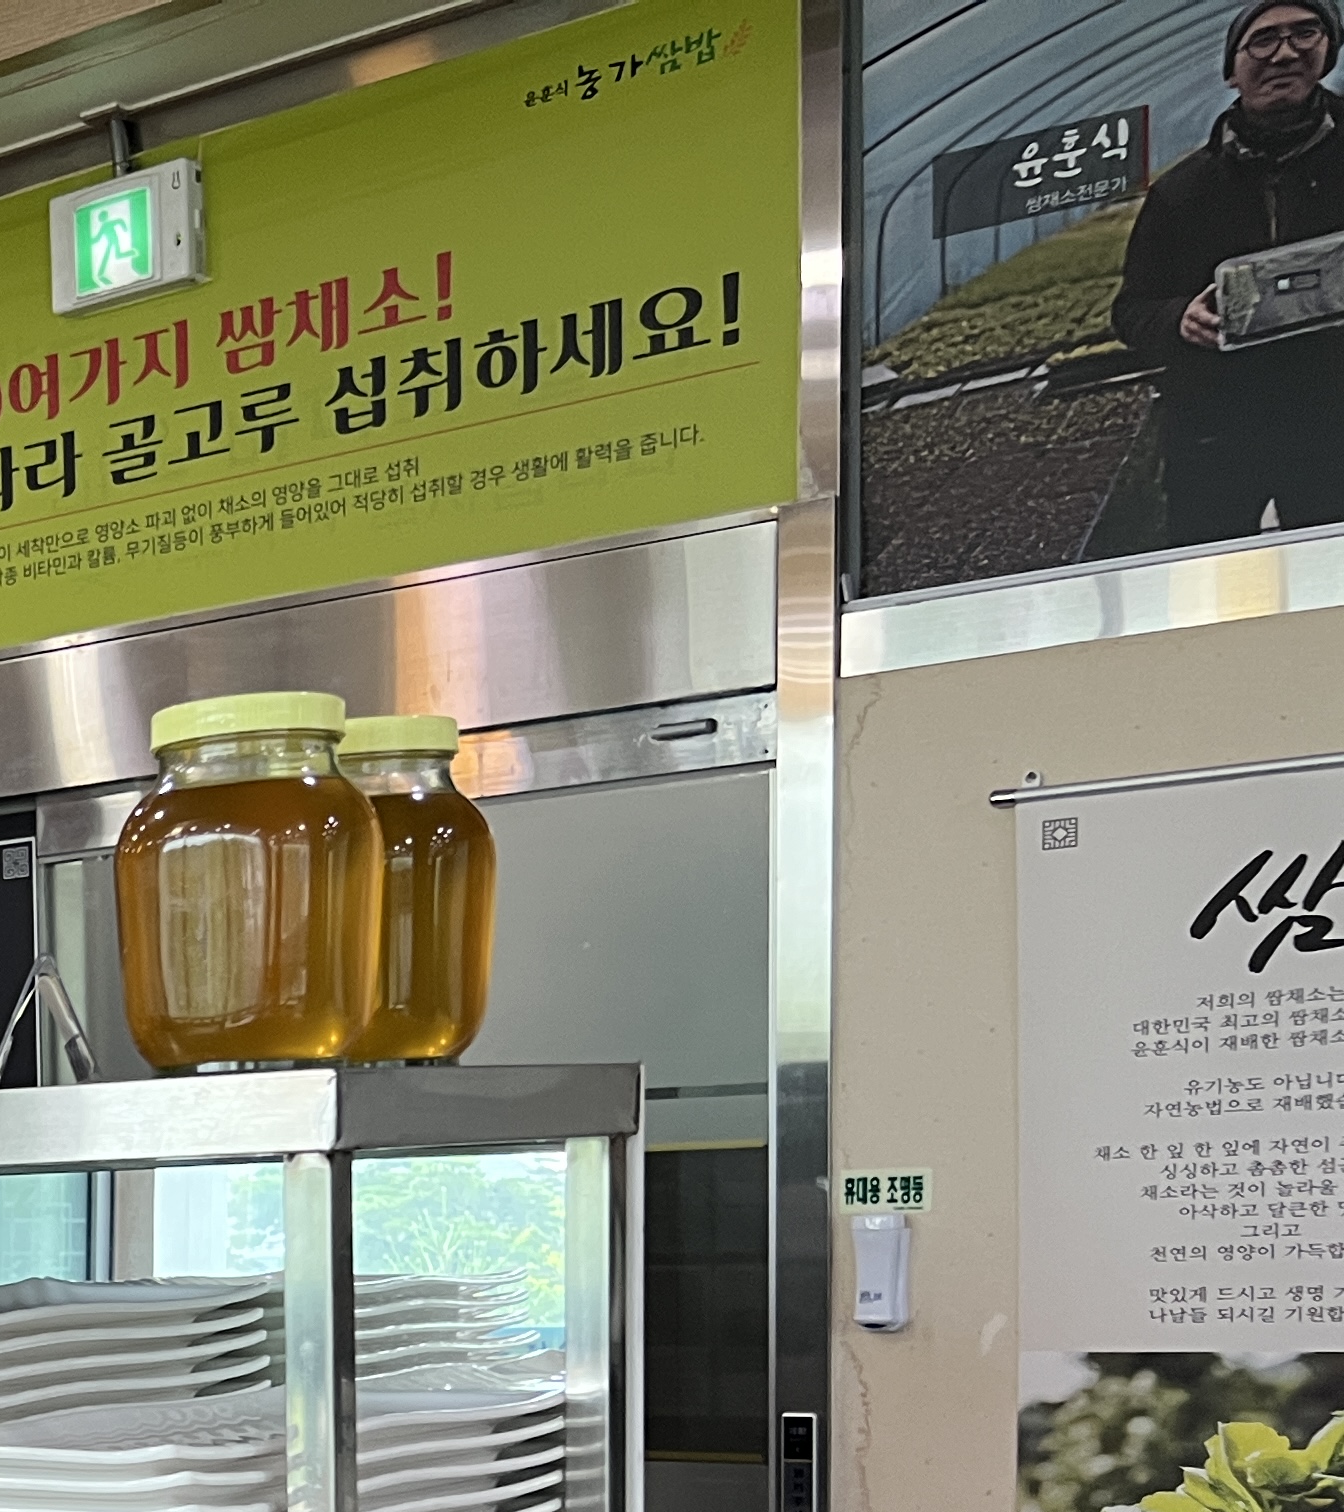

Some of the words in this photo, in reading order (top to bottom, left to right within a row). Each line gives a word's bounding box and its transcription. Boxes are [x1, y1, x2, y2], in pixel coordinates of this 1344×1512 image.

[1012, 116, 1130, 189] 윤훈식
[215, 250, 453, 375] 쌈채소!
[101, 382, 300, 486] 골고루
[324, 271, 741, 436] 섭취하세요!
[22, 551, 82, 582] 비타민과
[208, 512, 275, 545] 풍부하게
[278, 496, 347, 531] 들어있어
[352, 484, 405, 514] 적당히
[409, 473, 464, 503] 섭취할
[469, 464, 507, 491] 경우
[511, 451, 569, 483] 생활에
[574, 438, 634, 469] 활력을
[639, 423, 706, 457] 줍니다.
[94, 515, 142, 545] 영양소
[180, 501, 213, 526] 없이
[217, 488, 267, 517] 채소의
[271, 477, 323, 506] 영양을
[326, 466, 380, 494] 그대로
[384, 455, 420, 483] 섭취
[1195, 991, 1256, 1011] 저희의
[1132, 1015, 1212, 1037] 대한민국
[1219, 1010, 1280, 1031] 최고의
[1130, 1036, 1210, 1059] 윤훈식이
[1218, 1032, 1279, 1052] 재배한
[1183, 1076, 1266, 1097] 유기농도
[1143, 1097, 1265, 1119] 자연농법으로
[1093, 1145, 1131, 1162] 채소
[1139, 1143, 1159, 1161] 한
[1166, 1142, 1185, 1160] 잎
[1192, 1141, 1213, 1158] 한
[1221, 1139, 1261, 1157] 잎에
[1268, 1135, 1331, 1155] 자연이
[1159, 1161, 1239, 1180] 싱싱하고
[843, 1175, 883, 1206] 휴대용
[886, 1173, 925, 1205] 조명등
[1140, 1183, 1219, 1201] 채소라는
[1227, 1180, 1266, 1199] 것이
[1178, 1202, 1260, 1220] 아삭하고
[1267, 1199, 1330, 1219] 달큰한
[1239, 1222, 1303, 1240] 그리고
[1150, 1245, 1207, 1263] 천연의
[1216, 1243, 1276, 1262] 영양이
[1148, 1285, 1208, 1304] 맛있게
[1216, 1284, 1278, 1303] 드시고
[1284, 1284, 1325, 1303] 생명
[1148, 1306, 1208, 1325] 나날들
[1216, 1305, 1276, 1324] 되시길
